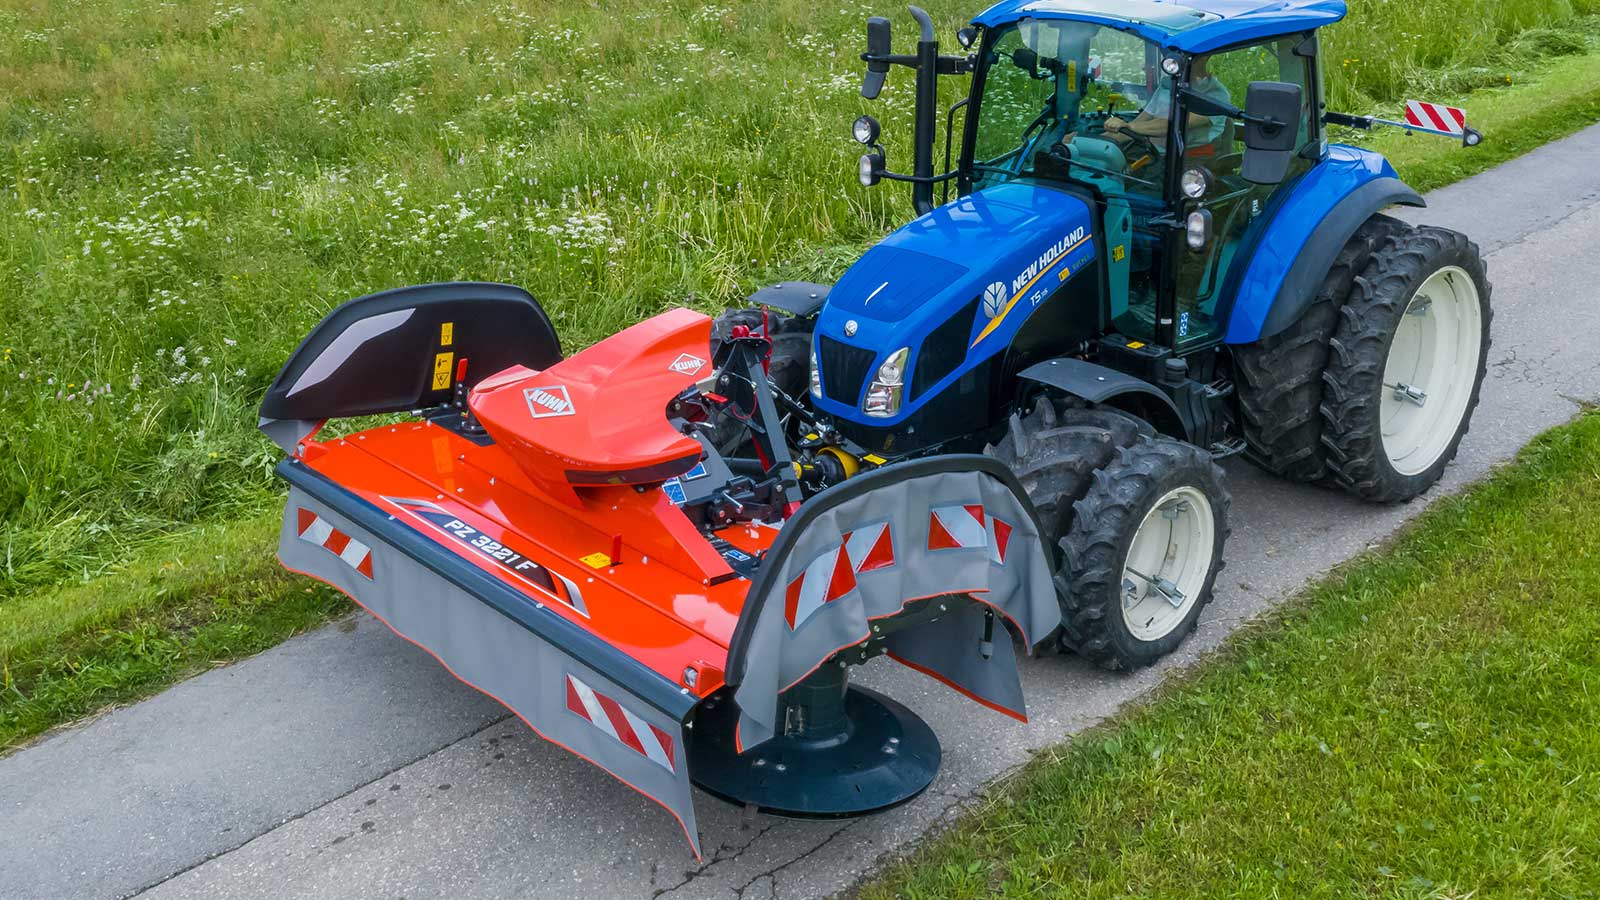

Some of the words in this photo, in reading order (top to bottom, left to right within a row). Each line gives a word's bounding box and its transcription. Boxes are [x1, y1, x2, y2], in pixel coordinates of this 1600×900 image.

[1012, 260, 1037, 294] NEW
[1039, 226, 1084, 270] HOLLAND
[674, 359, 701, 371] KUHN
[529, 389, 569, 413] KUHN
[443, 519, 477, 538] PZ
[470, 535, 521, 564] 3221
[514, 560, 539, 570] F
